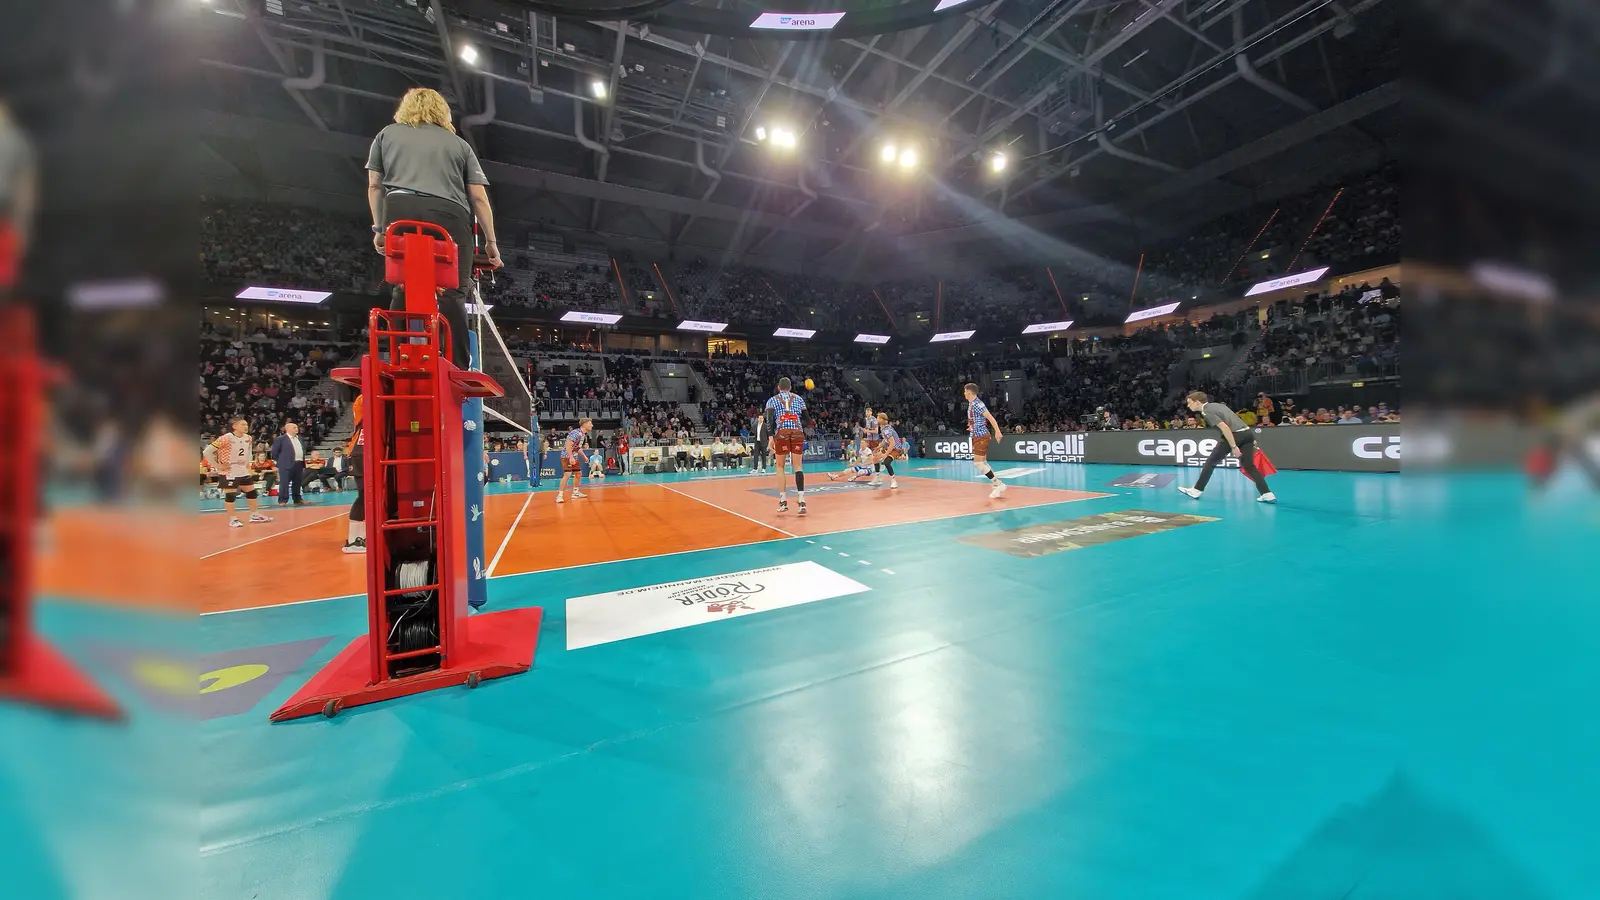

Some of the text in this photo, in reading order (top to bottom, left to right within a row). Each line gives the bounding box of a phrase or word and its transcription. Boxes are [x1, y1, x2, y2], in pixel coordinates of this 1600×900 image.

[1279, 278, 1300, 287] arena
[238, 448, 245, 456] 2
[935, 437, 973, 457] capel
[1015, 434, 1085, 459] capelli
[1138, 439, 1218, 463] cape
[1045, 454, 1085, 463] SPORT
[675, 581, 766, 606] RÖDER
